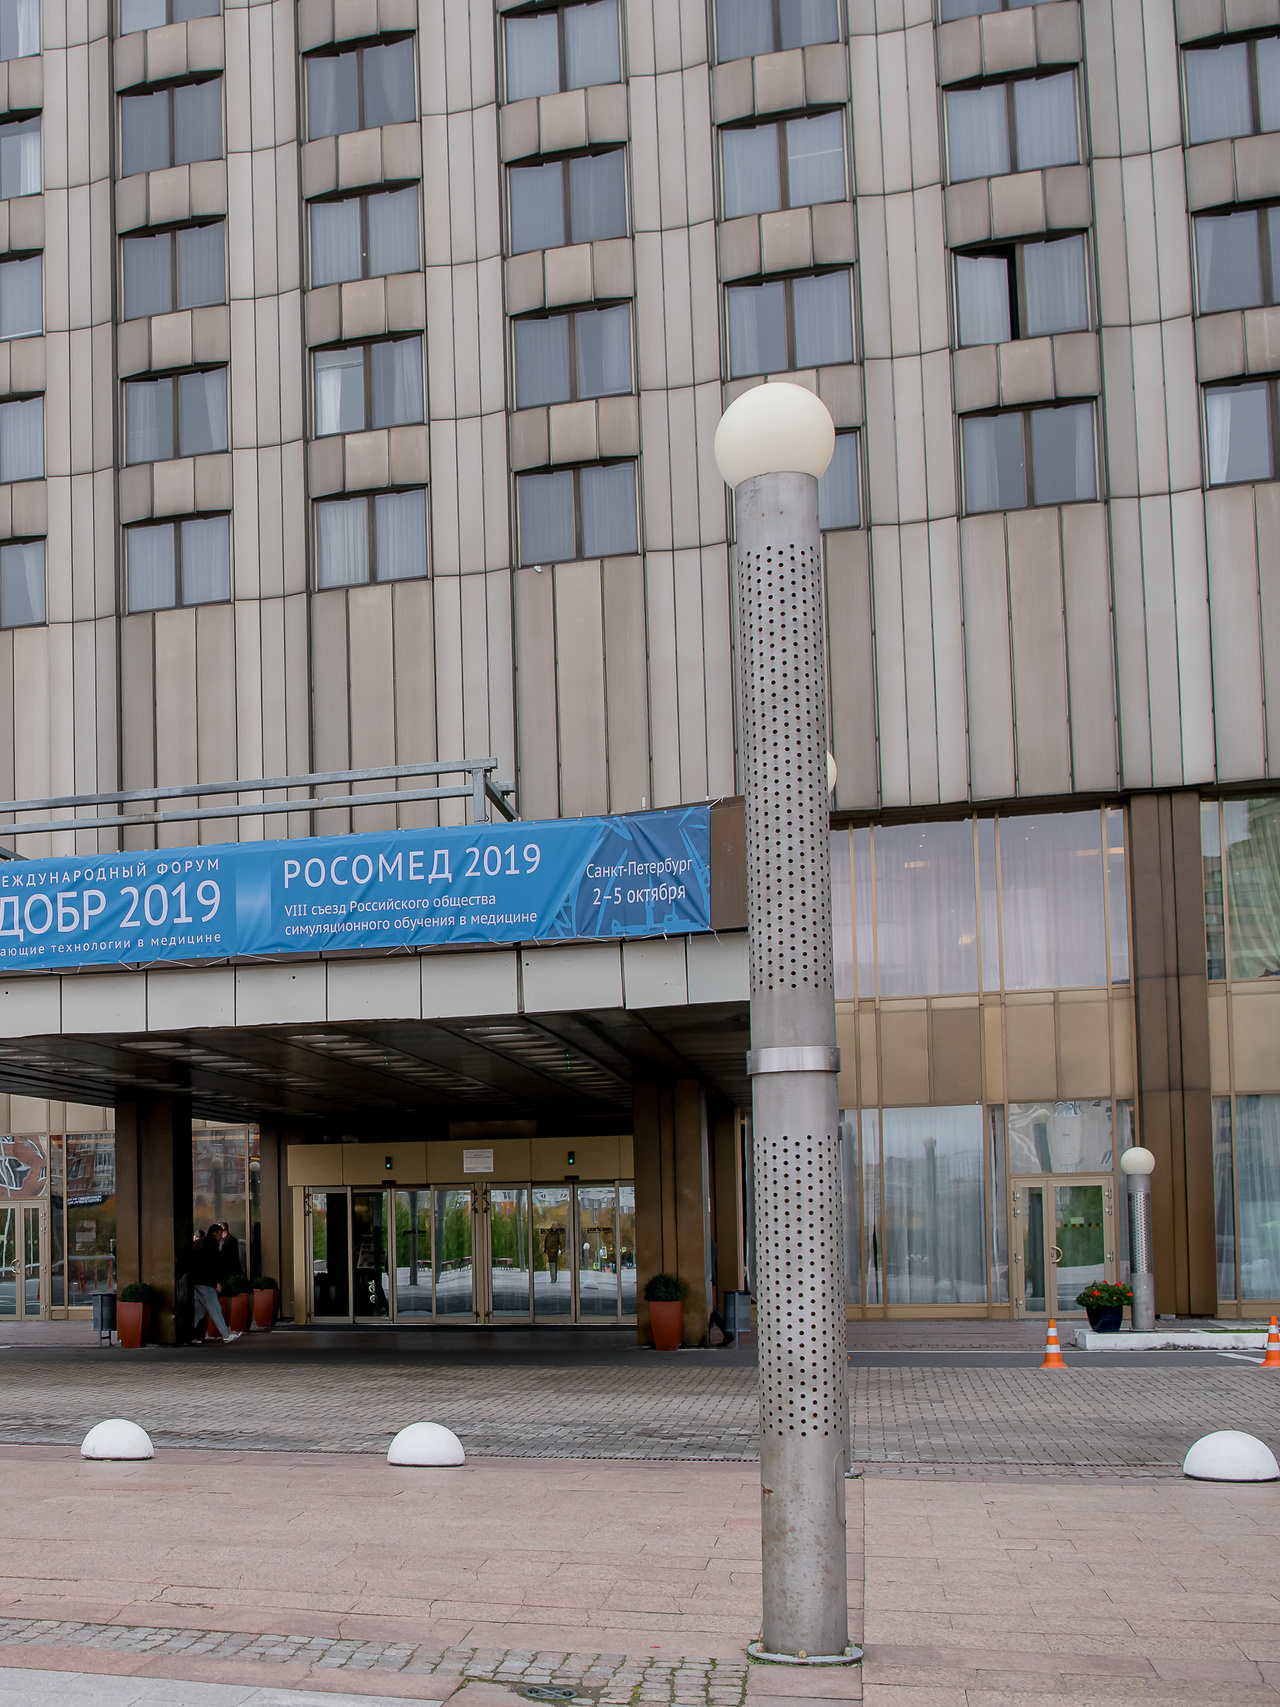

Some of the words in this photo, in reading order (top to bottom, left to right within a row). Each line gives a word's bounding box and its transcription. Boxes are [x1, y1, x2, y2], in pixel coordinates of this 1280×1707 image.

[156, 858, 219, 875] ФОРУМ
[284, 848, 453, 889] РОСОМЕД
[464, 843, 541, 877] 2019
[586, 857, 693, 879] Санкт-Петербург
[119, 879, 221, 928] 2019
[627, 882, 686, 904] октября
[284, 903, 308, 917] VIII
[311, 904, 347, 916] съезд
[349, 898, 430, 913] Российского
[433, 894, 496, 908] общества
[285, 919, 390, 938] симуляционного
[393, 916, 455, 932] обучения
[459, 915, 467, 926] в
[470, 912, 538, 926] медицине
[50, 940, 131, 953] технологии
[137, 938, 144, 948] в
[151, 933, 221, 947] медицине
